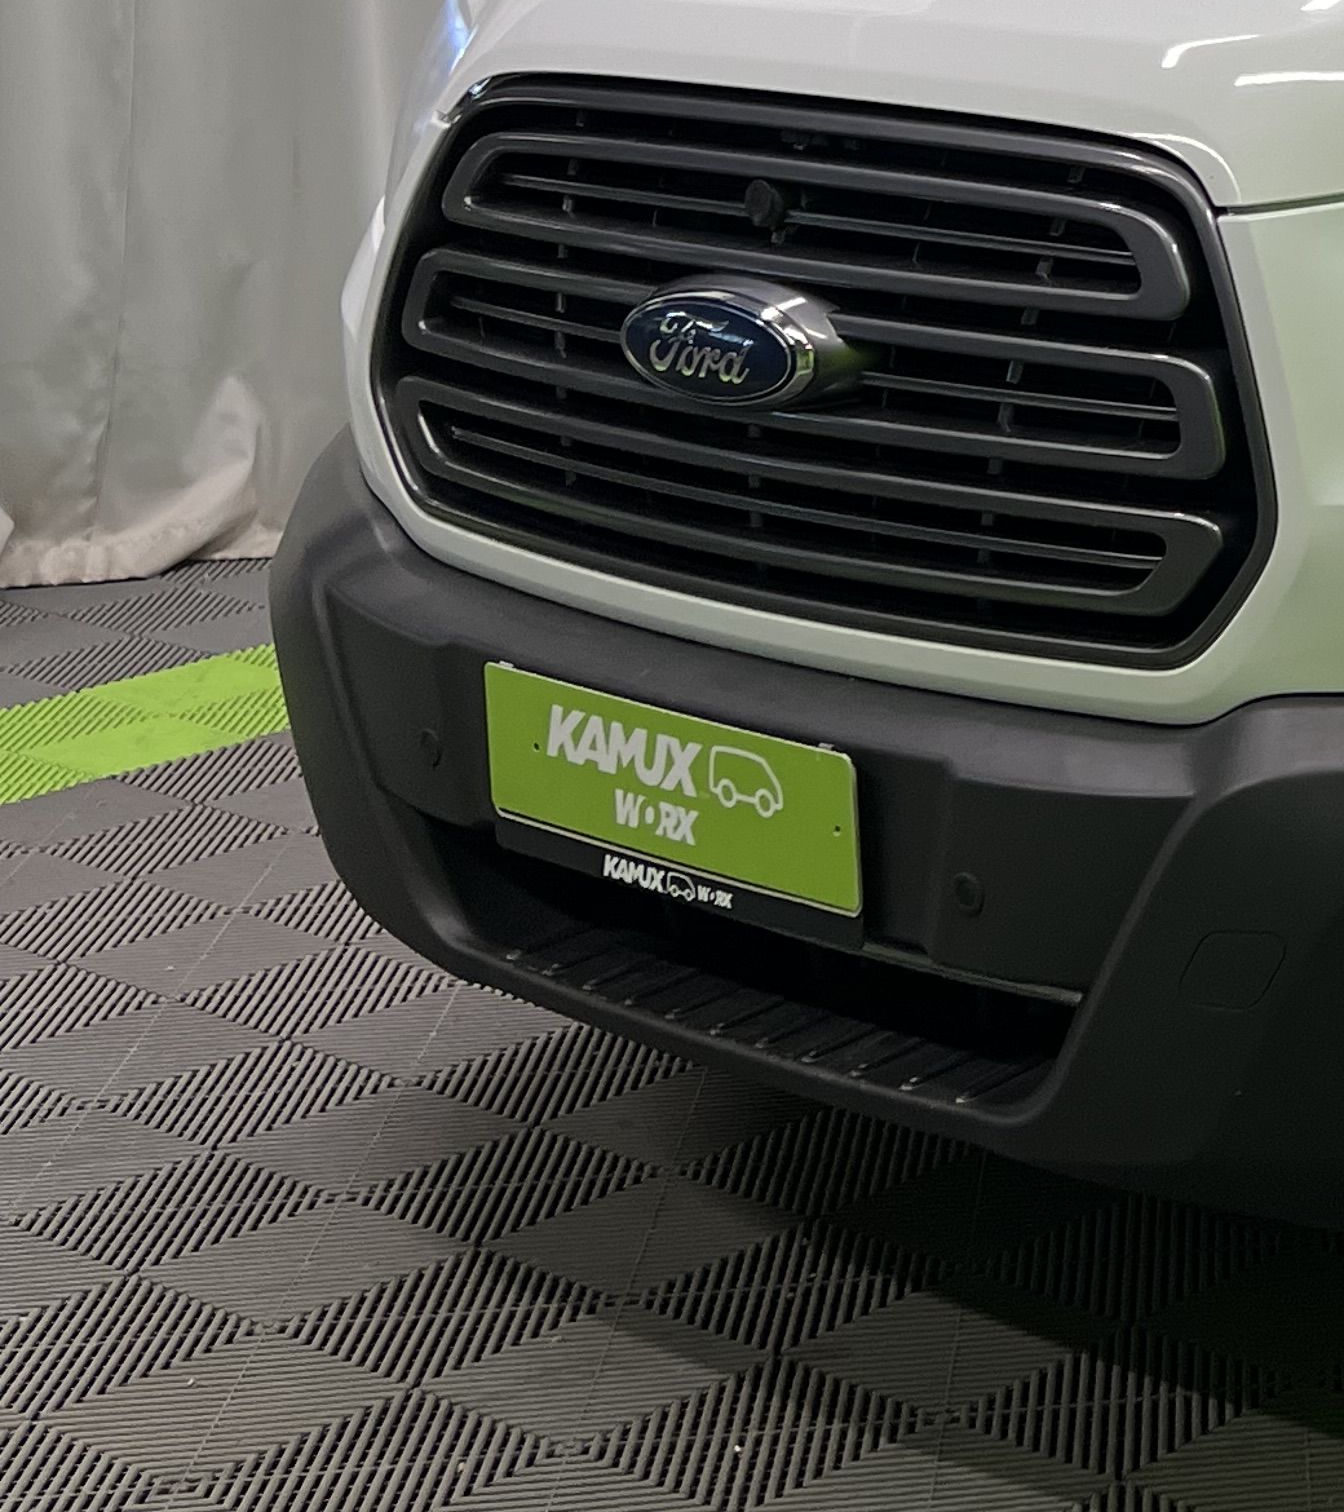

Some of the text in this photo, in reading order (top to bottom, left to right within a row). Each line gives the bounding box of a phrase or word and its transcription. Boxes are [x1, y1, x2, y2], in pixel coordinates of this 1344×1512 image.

[650, 311, 754, 385] Ford
[546, 703, 702, 798] KAMUX
[603, 854, 666, 894] KAMUX
